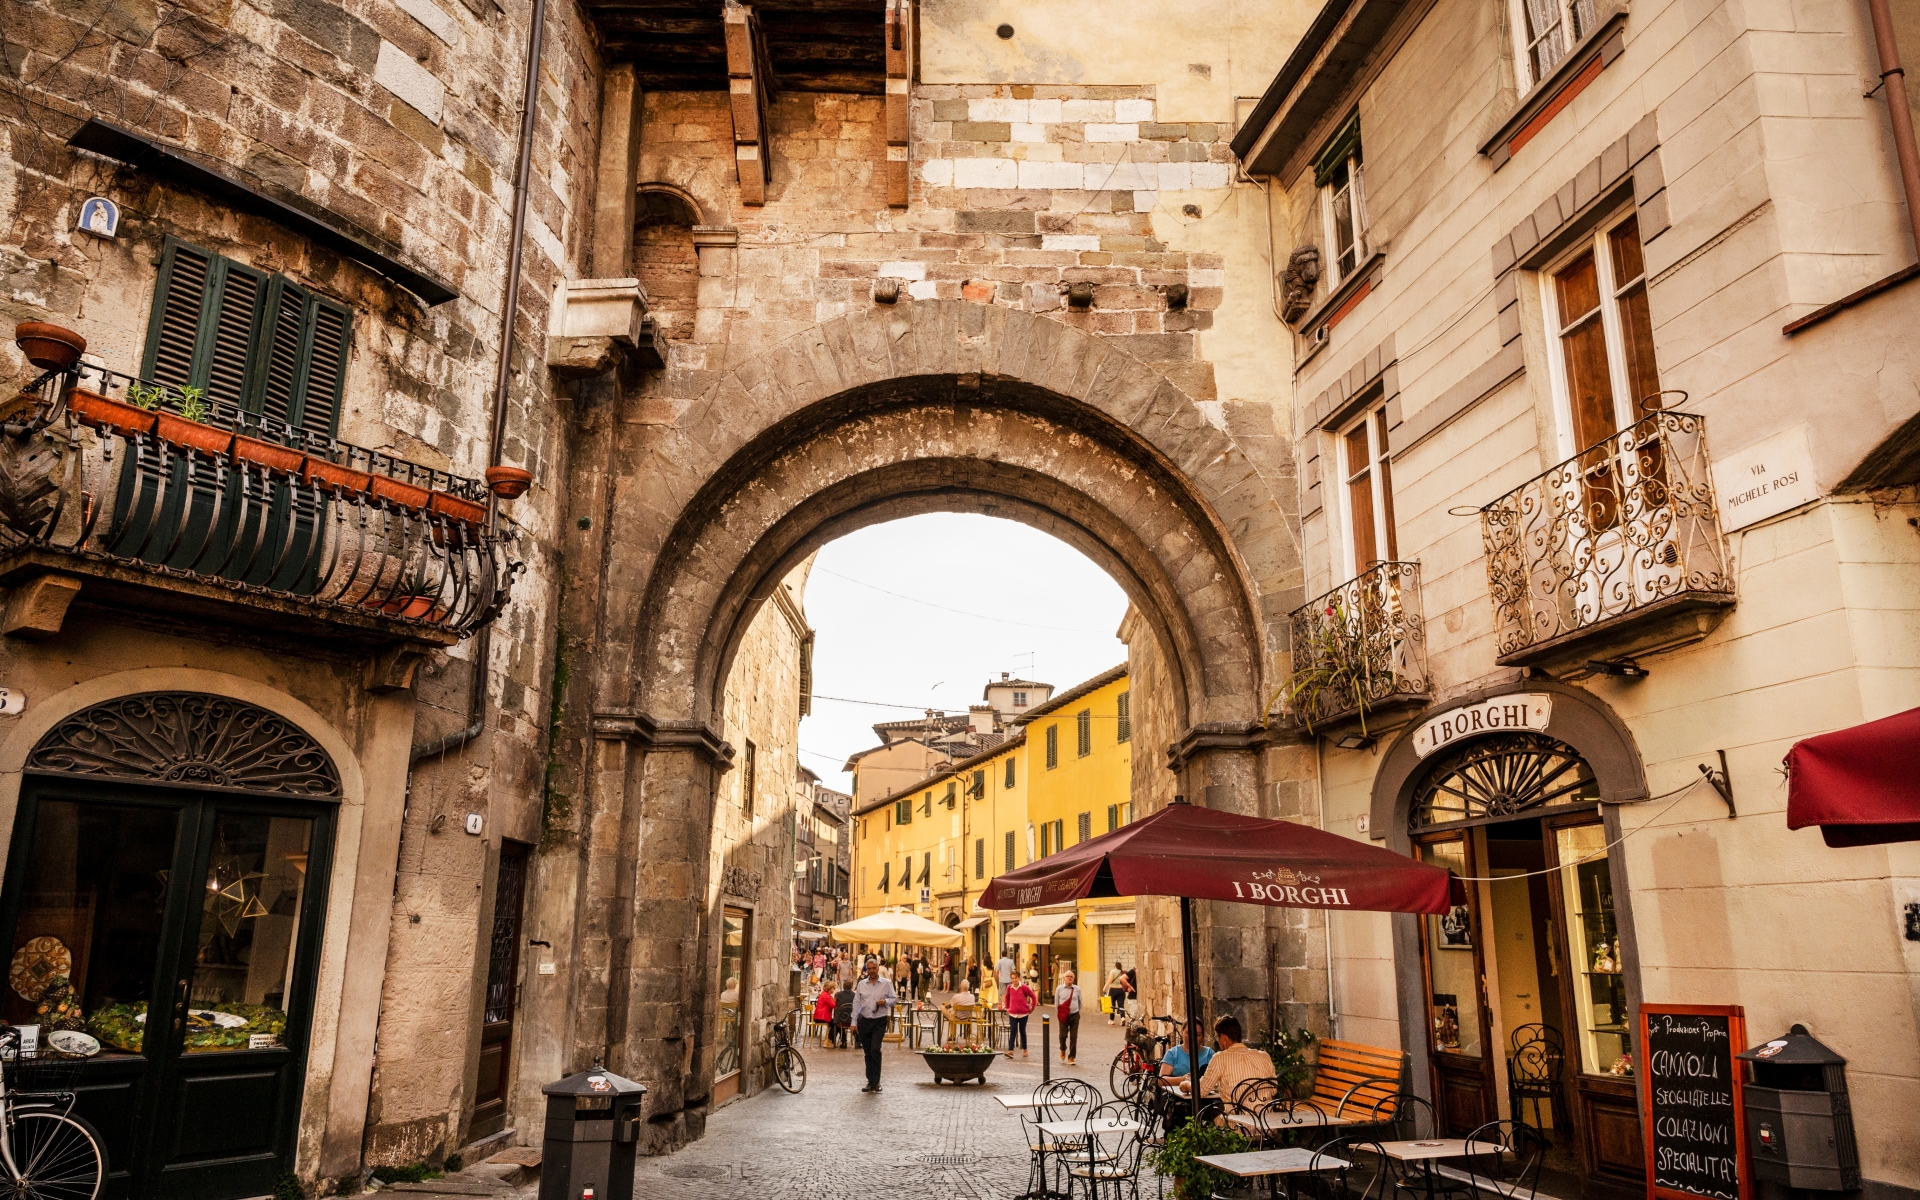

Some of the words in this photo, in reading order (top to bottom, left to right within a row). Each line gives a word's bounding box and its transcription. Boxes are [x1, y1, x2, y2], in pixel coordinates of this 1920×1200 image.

[1750, 463, 1766, 476] VIA
[1728, 483, 1770, 510] MICHELE
[1772, 471, 1799, 491] ROSI
[1429, 725, 1439, 747] I
[1440, 703, 1529, 743] BORGHI
[471, 817, 478, 830] 4
[1360, 816, 1365, 830] 3
[1231, 881, 1245, 899] I
[1246, 882, 1351, 906] BORGHI
[1651, 1050, 1719, 1079] CANNOLI
[1656, 1087, 1732, 1108] SFOGLIATELLE
[1656, 1116, 1729, 1146] COLAZIONI
